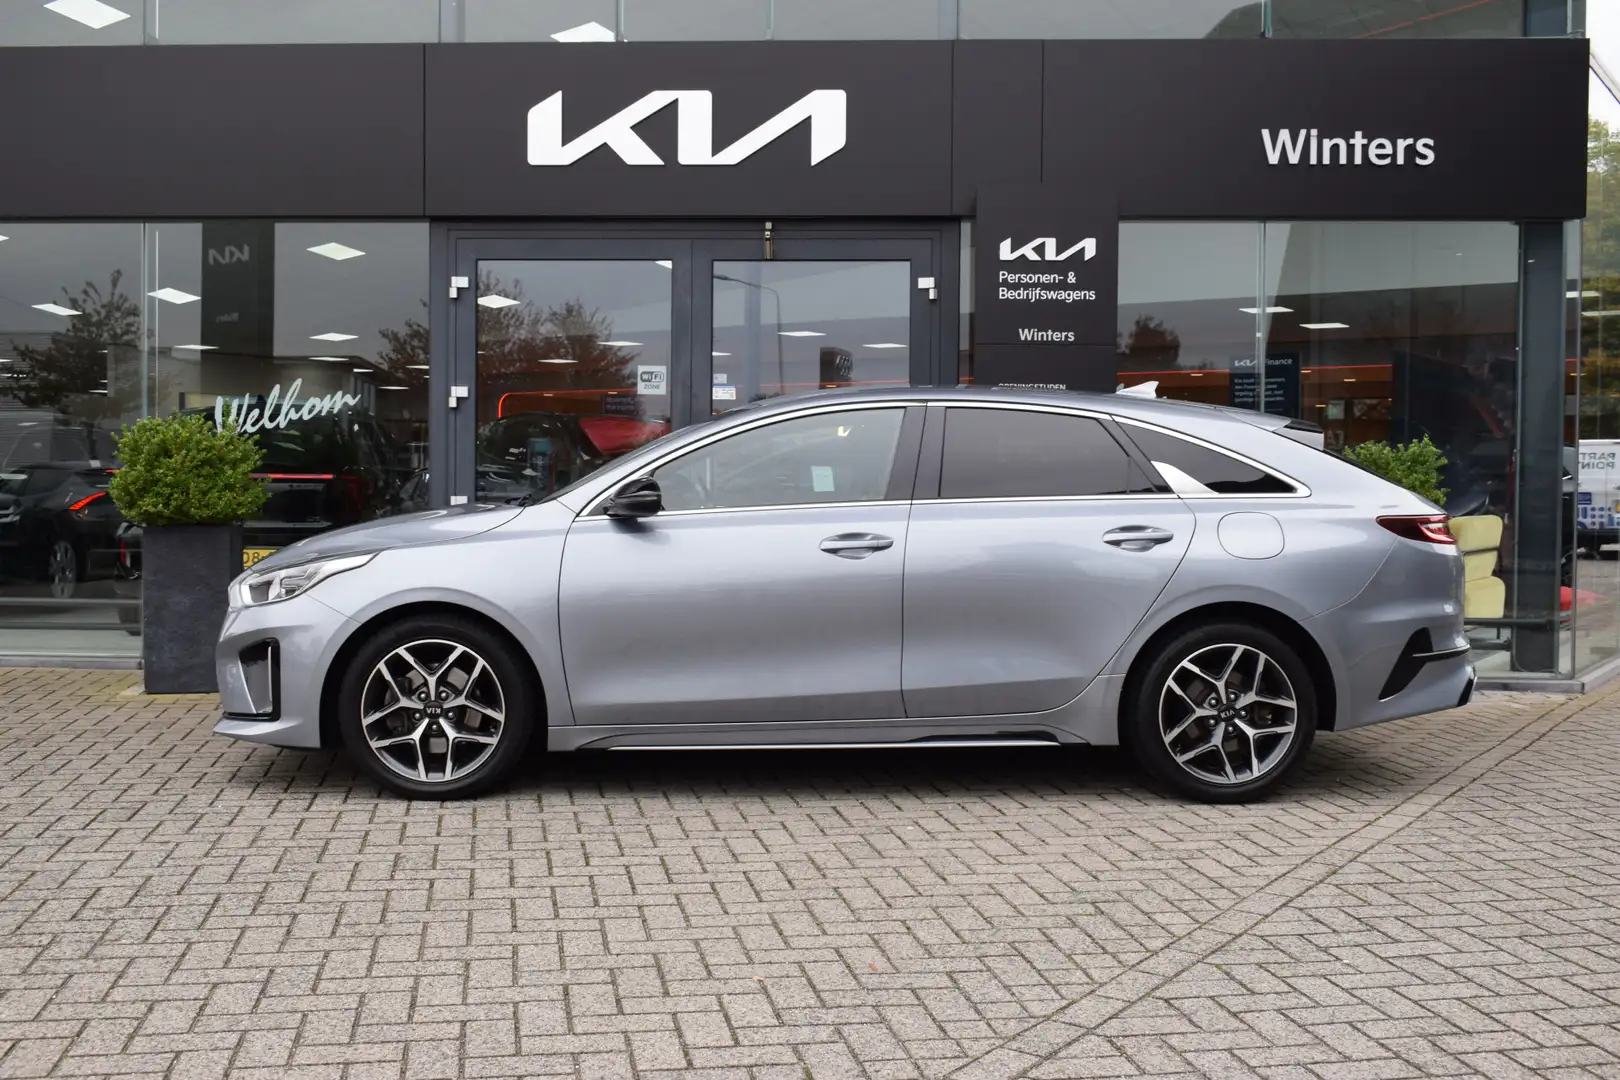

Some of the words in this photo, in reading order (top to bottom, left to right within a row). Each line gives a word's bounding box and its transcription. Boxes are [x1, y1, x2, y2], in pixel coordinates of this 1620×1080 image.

[527, 89, 847, 166] KIA
[1260, 128, 1435, 166] Winters
[999, 237, 1097, 261] KIA
[999, 270, 1064, 283] Personen-
[1067, 271, 1076, 283] &
[999, 287, 1096, 303] Bedrijfswagens
[1018, 328, 1075, 341] Winters
[1220, 709, 1235, 718] KIA
